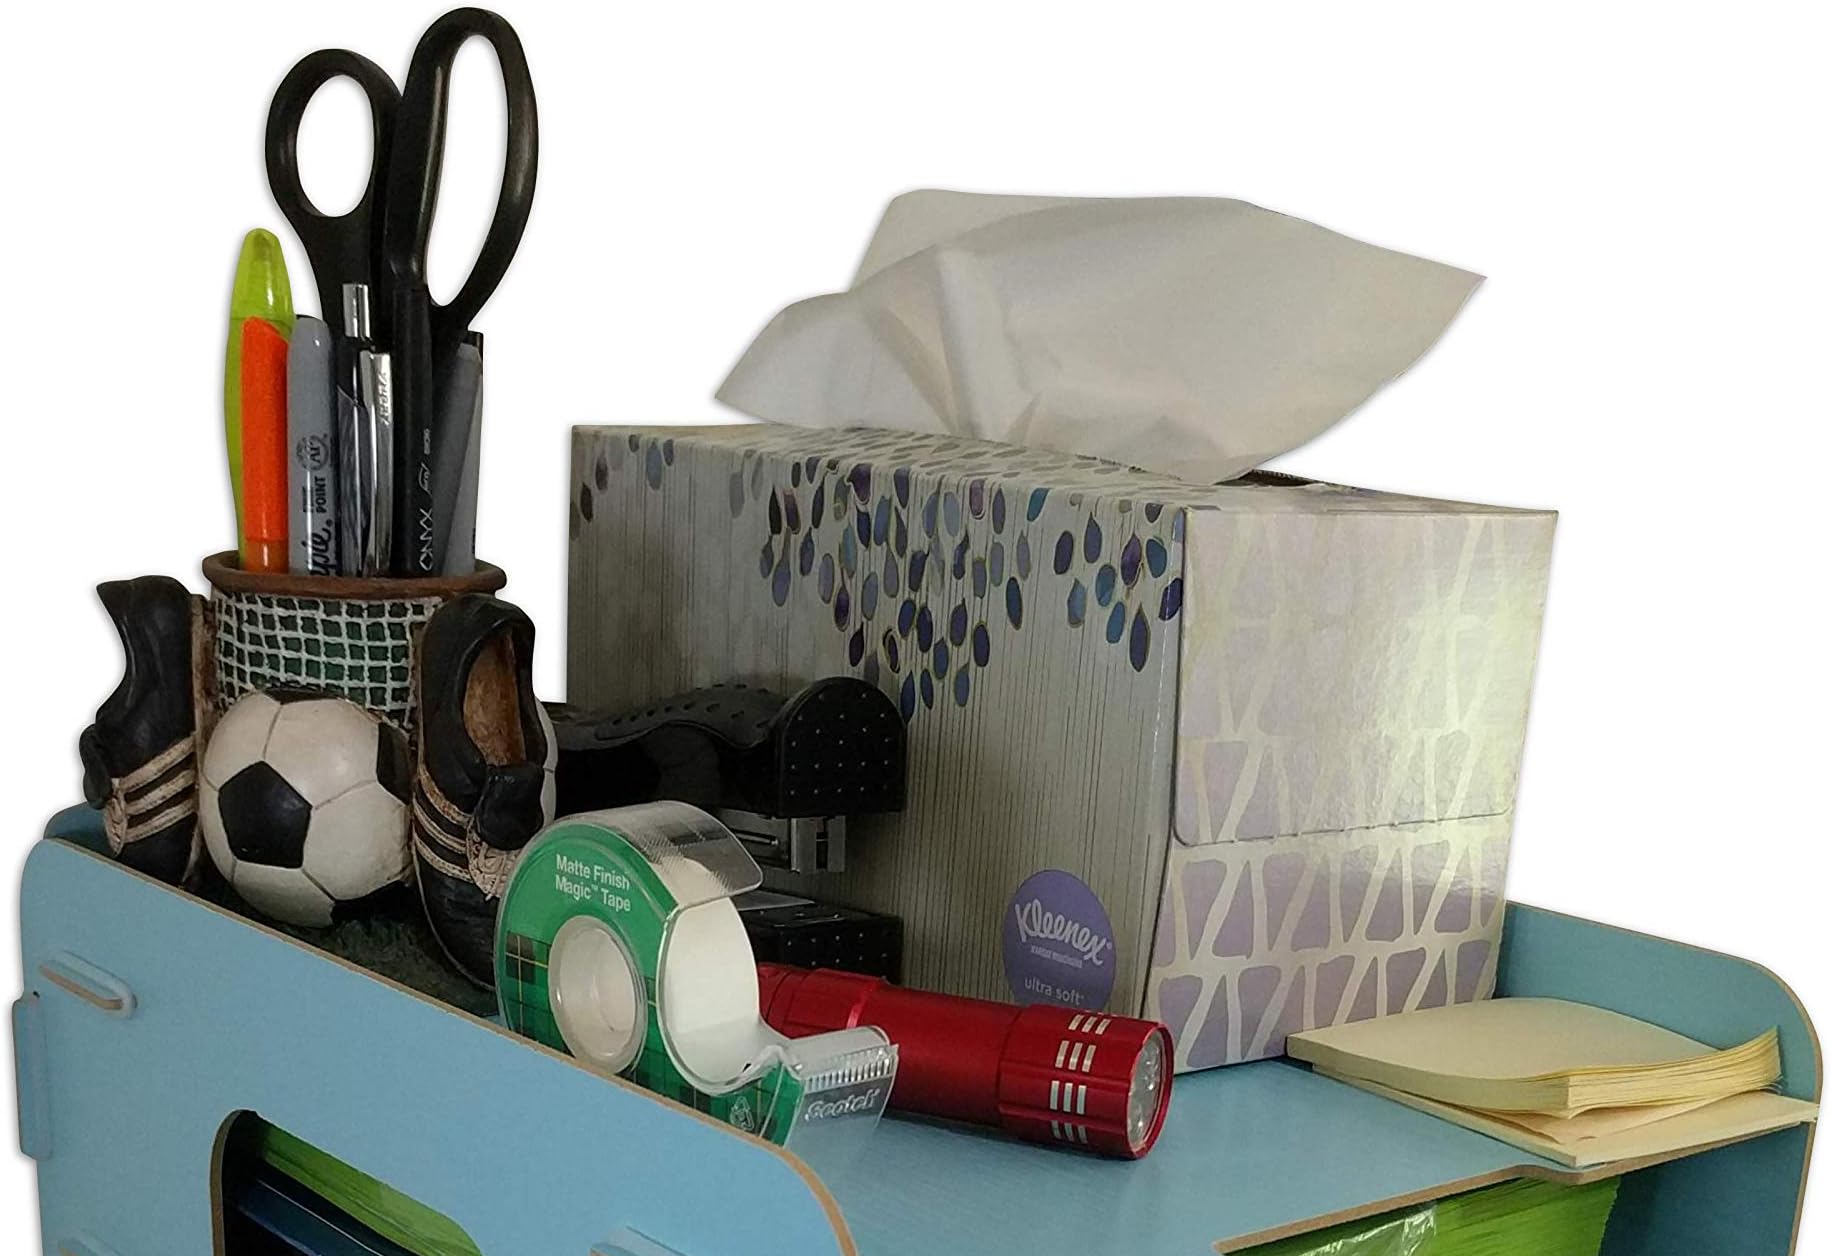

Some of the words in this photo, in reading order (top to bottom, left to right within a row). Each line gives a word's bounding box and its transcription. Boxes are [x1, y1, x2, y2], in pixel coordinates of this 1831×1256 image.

[315, 476, 327, 514] POINT
[420, 508, 433, 571] ONYX
[556, 853, 591, 879] Matte
[593, 865, 630, 891] Finish
[601, 888, 631, 912] Tape
[1024, 977, 1052, 996] ultra
[805, 1088, 881, 1122] Scotch
